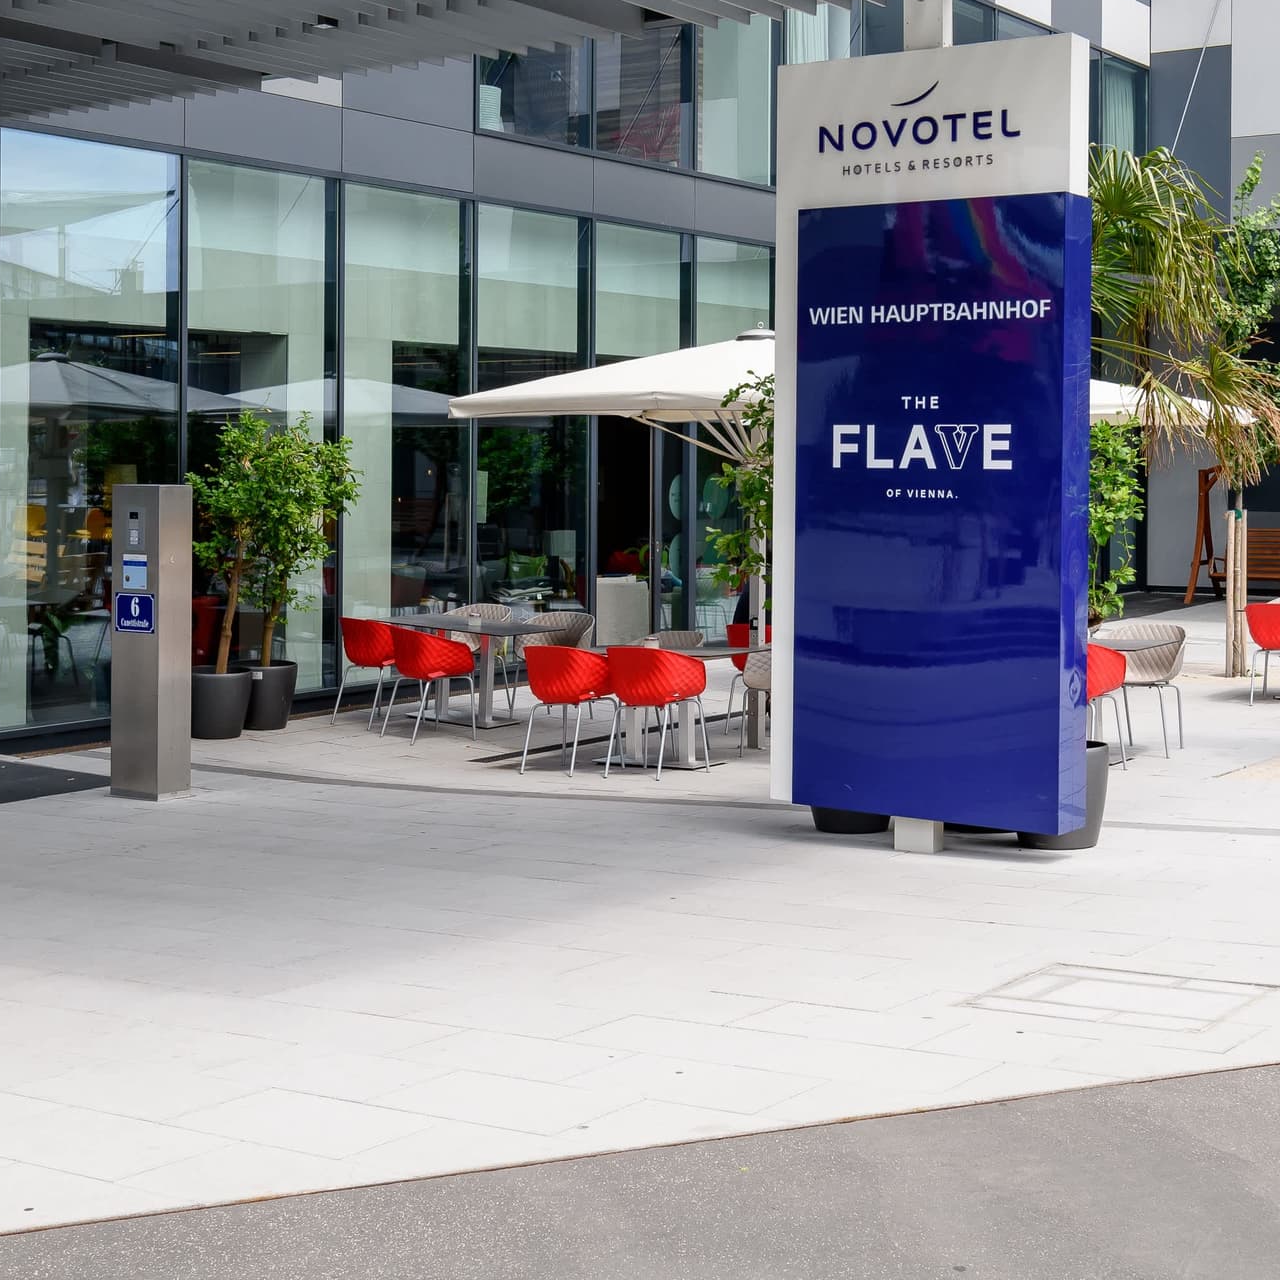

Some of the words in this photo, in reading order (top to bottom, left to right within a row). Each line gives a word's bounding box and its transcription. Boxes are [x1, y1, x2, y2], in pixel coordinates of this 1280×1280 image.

[818, 109, 1022, 154] NOVOTEL
[842, 160, 902, 176] HOTELS
[907, 159, 917, 171] &
[922, 154, 995, 170] RESORTS
[809, 304, 864, 326] WIEN
[870, 299, 1052, 325] HAUPTBAHNHOF
[901, 395, 940, 410] THE
[832, 423, 1014, 470] FLAVE
[886, 488, 902, 498] OF
[907, 489, 959, 499] VIENNA.
[130, 596, 140, 617] 6
